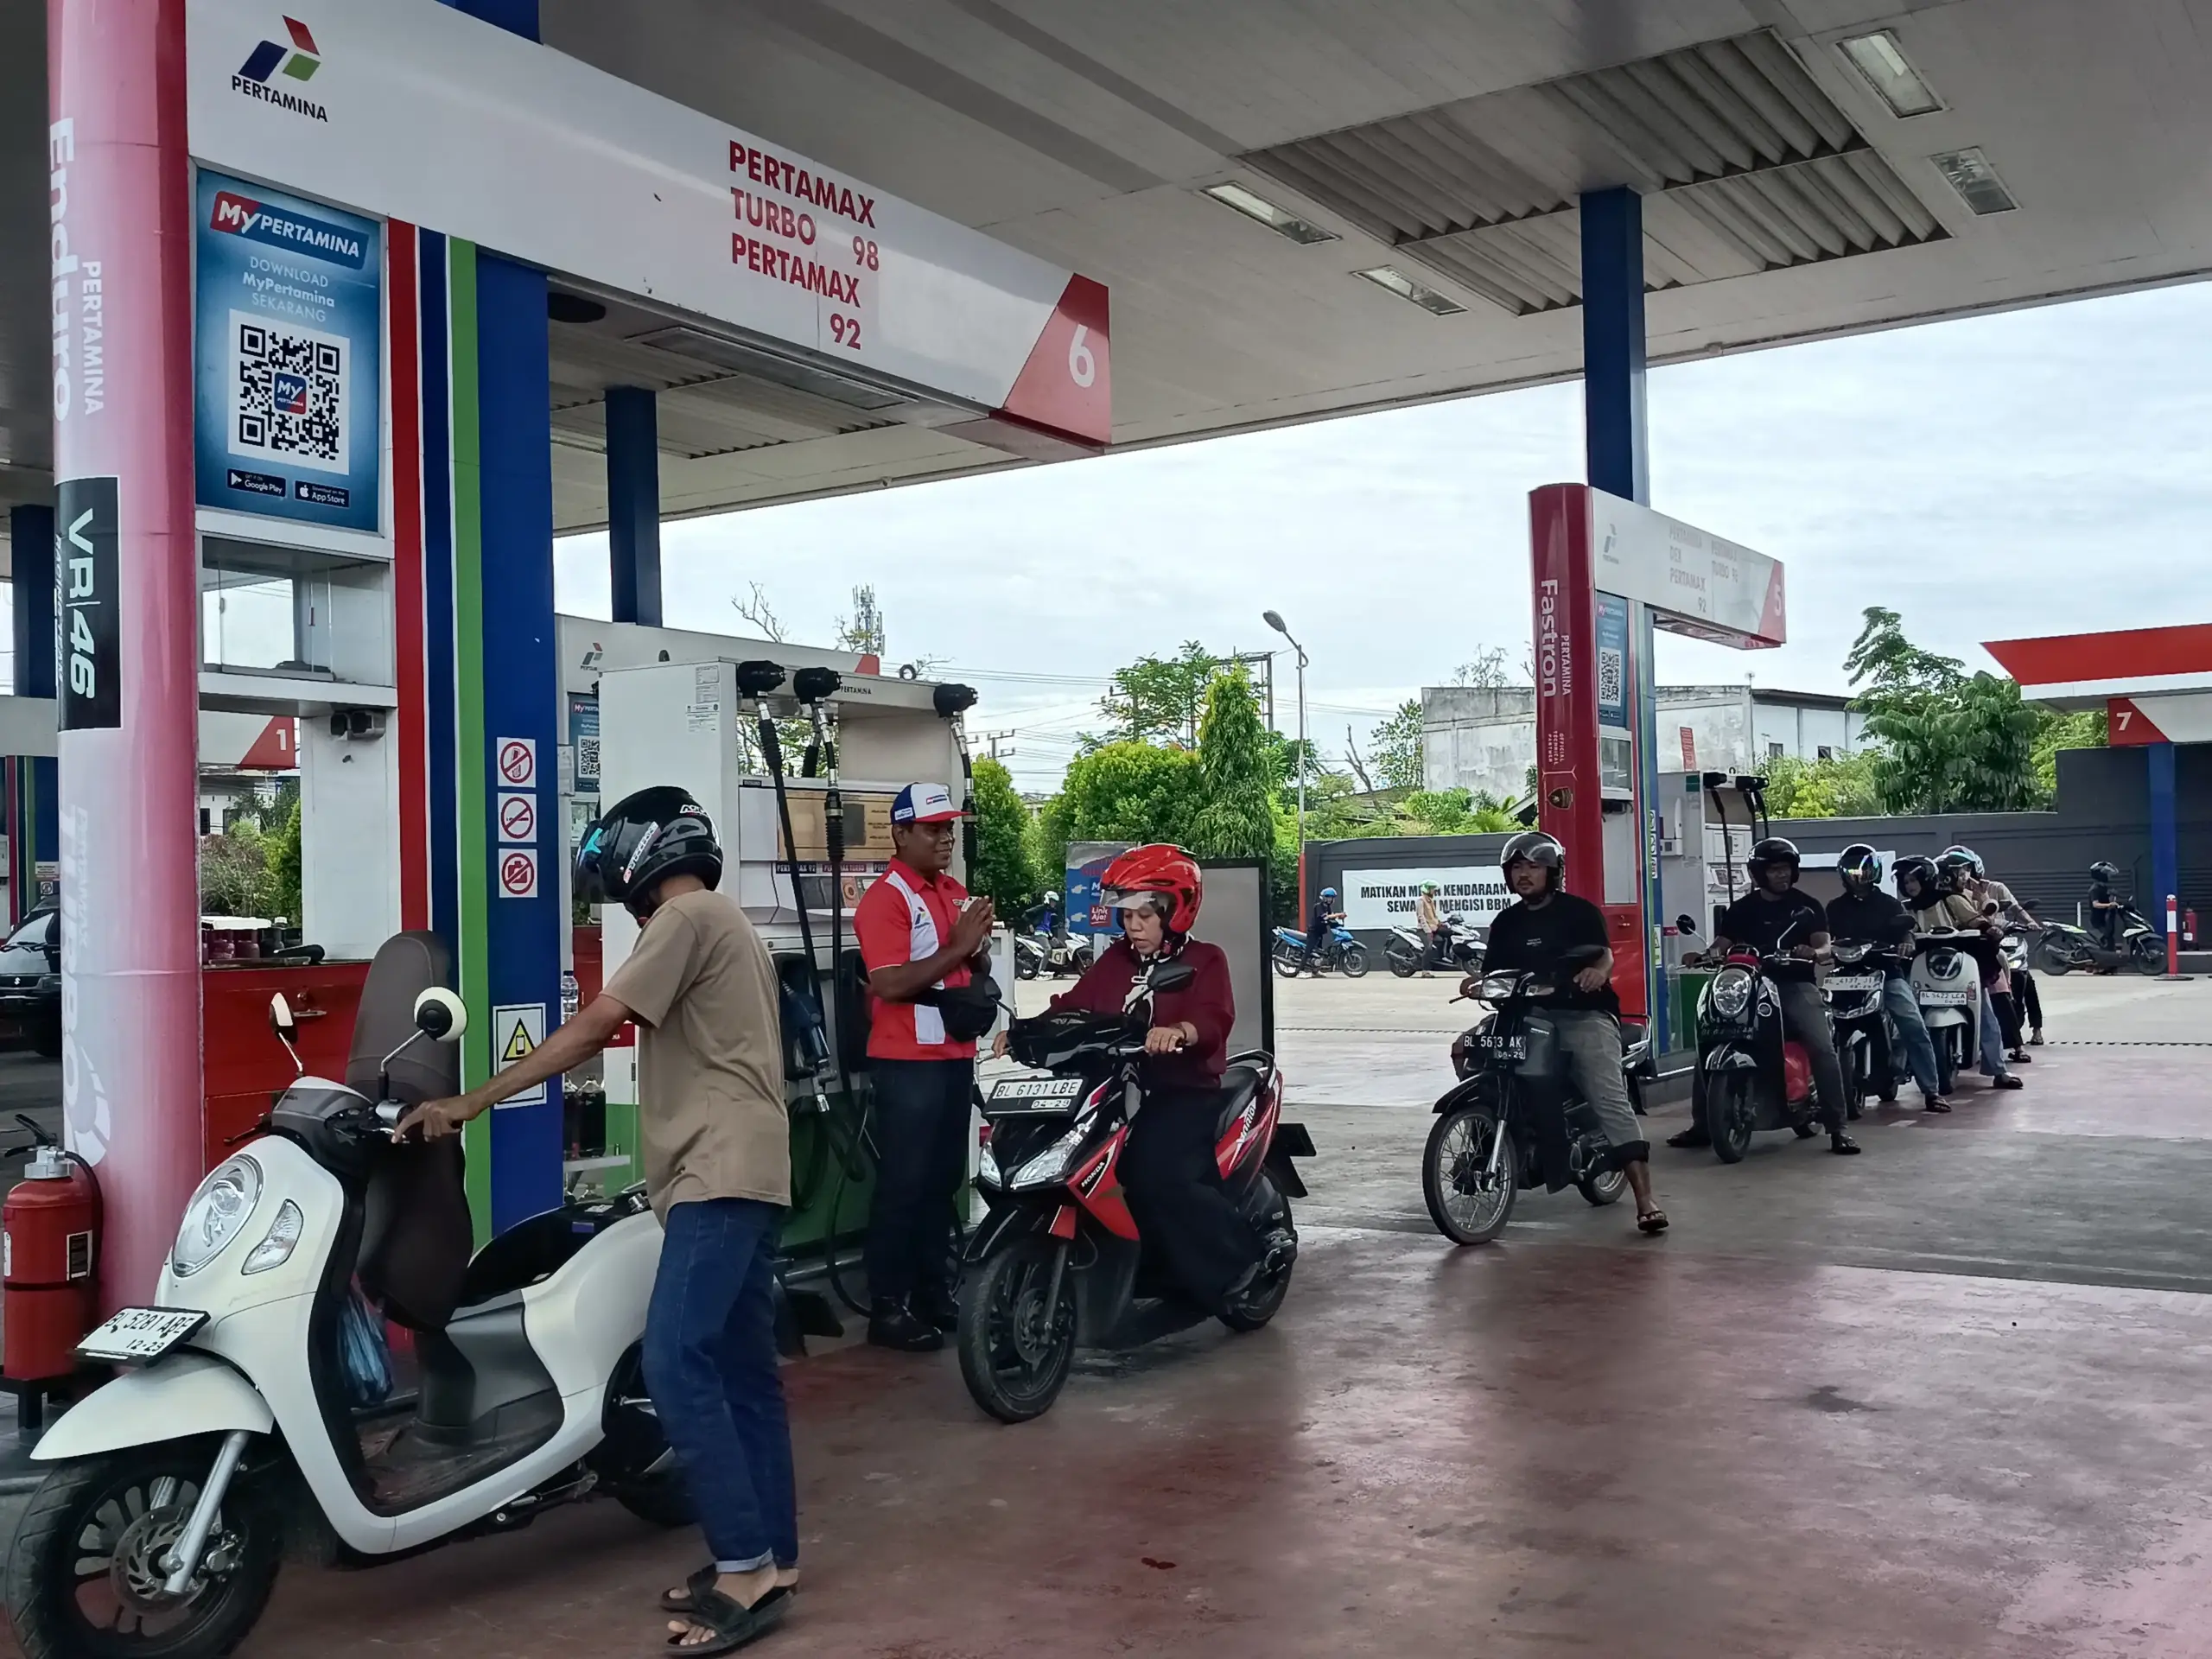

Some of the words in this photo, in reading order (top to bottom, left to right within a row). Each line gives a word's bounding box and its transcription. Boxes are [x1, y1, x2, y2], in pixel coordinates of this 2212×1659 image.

[231, 75, 328, 123] PERTAMINA
[729, 140, 875, 228] PERTAMAX
[730, 187, 816, 245] TURBO
[853, 236, 880, 271] 98
[50, 118, 78, 421] Enduro
[250, 257, 328, 287] DOWNLOAD
[732, 232, 861, 308] PERTAMAX
[243, 272, 335, 308] MyPertamina
[251, 293, 326, 322] SEKARANG
[82, 262, 104, 415] PERTAMINA
[830, 313, 861, 350] 92
[1068, 322, 1095, 387] 6
[245, 480, 268, 491] Google
[270, 484, 283, 493] Play
[312, 493, 326, 503] App
[327, 495, 345, 505] Store
[1775, 584, 1783, 616] 5
[1541, 579, 1558, 697] Fastron
[1560, 635, 1572, 696] PERTAMINA
[2116, 711, 2133, 731] 7
[276, 729, 287, 750] 1
[1361, 886, 1406, 899] MATIKAN
[1444, 883, 1507, 896] KENDARAAN
[1440, 898, 1484, 912] MENGISI
[1487, 898, 1511, 911] BBM
[1465, 1036, 1475, 1046] BL
[1509, 1036, 1522, 1048] AK
[996, 1085, 1010, 1096] BL
[1017, 1084, 1048, 1096] 6131
[1051, 1082, 1078, 1094] LBE
[1081, 1161, 1105, 1187] HONDA
[123, 1313, 165, 1331] 5281
[156, 1316, 194, 1335] ABE
